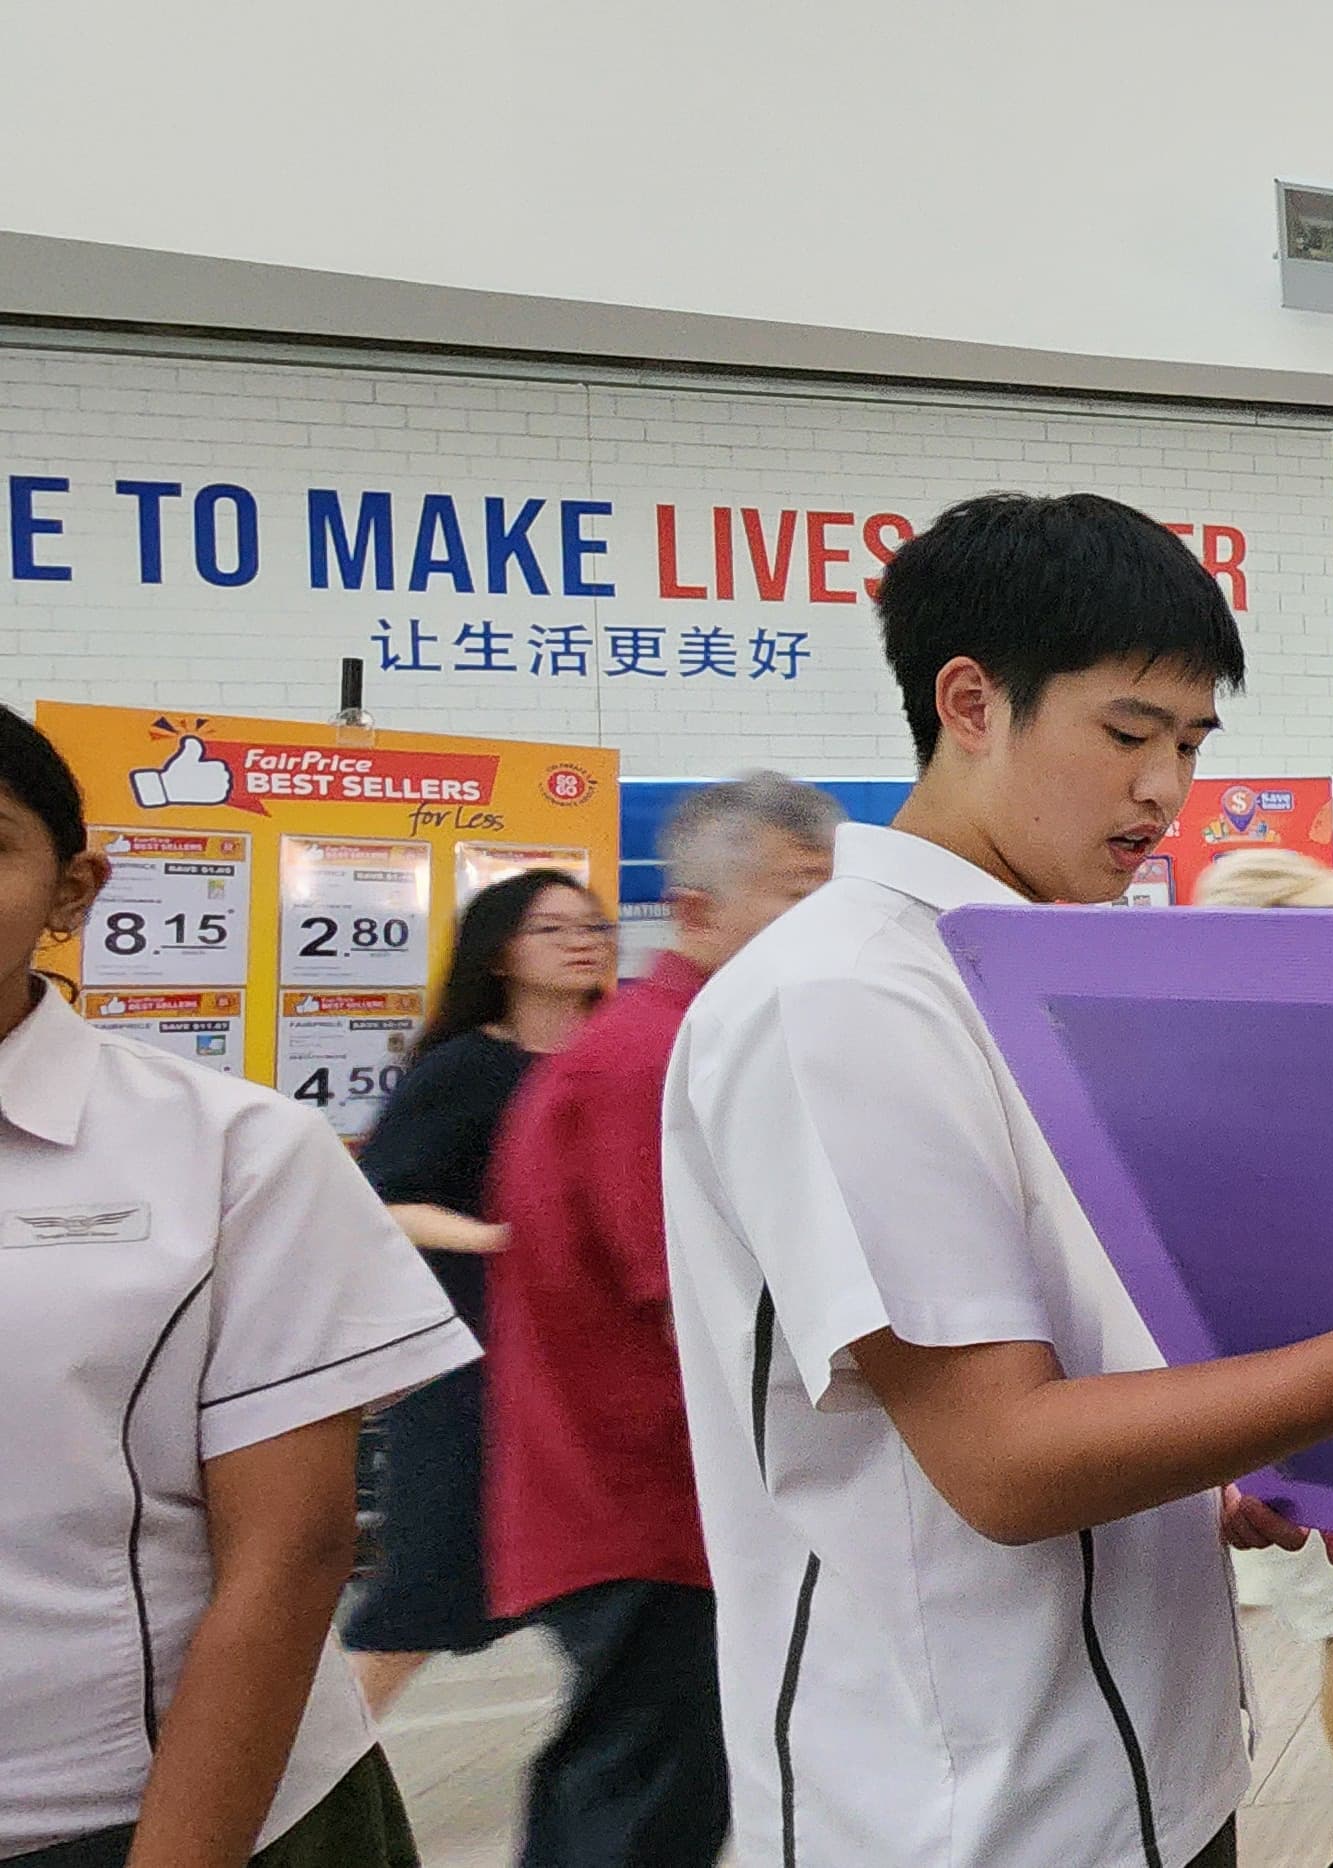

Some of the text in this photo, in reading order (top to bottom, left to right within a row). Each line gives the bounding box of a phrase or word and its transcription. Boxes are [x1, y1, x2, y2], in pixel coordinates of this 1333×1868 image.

[115, 480, 259, 587] TO
[308, 489, 615, 597] MAKE
[656, 504, 914, 604] LIVES
[371, 618, 811, 680] 让生活更美好
[245, 749, 373, 773] FairPrice
[247, 772, 480, 800] BEST SELLERS
[409, 801, 505, 836] for Less
[104, 911, 227, 956] 8.15
[299, 917, 409, 957] 2.80
